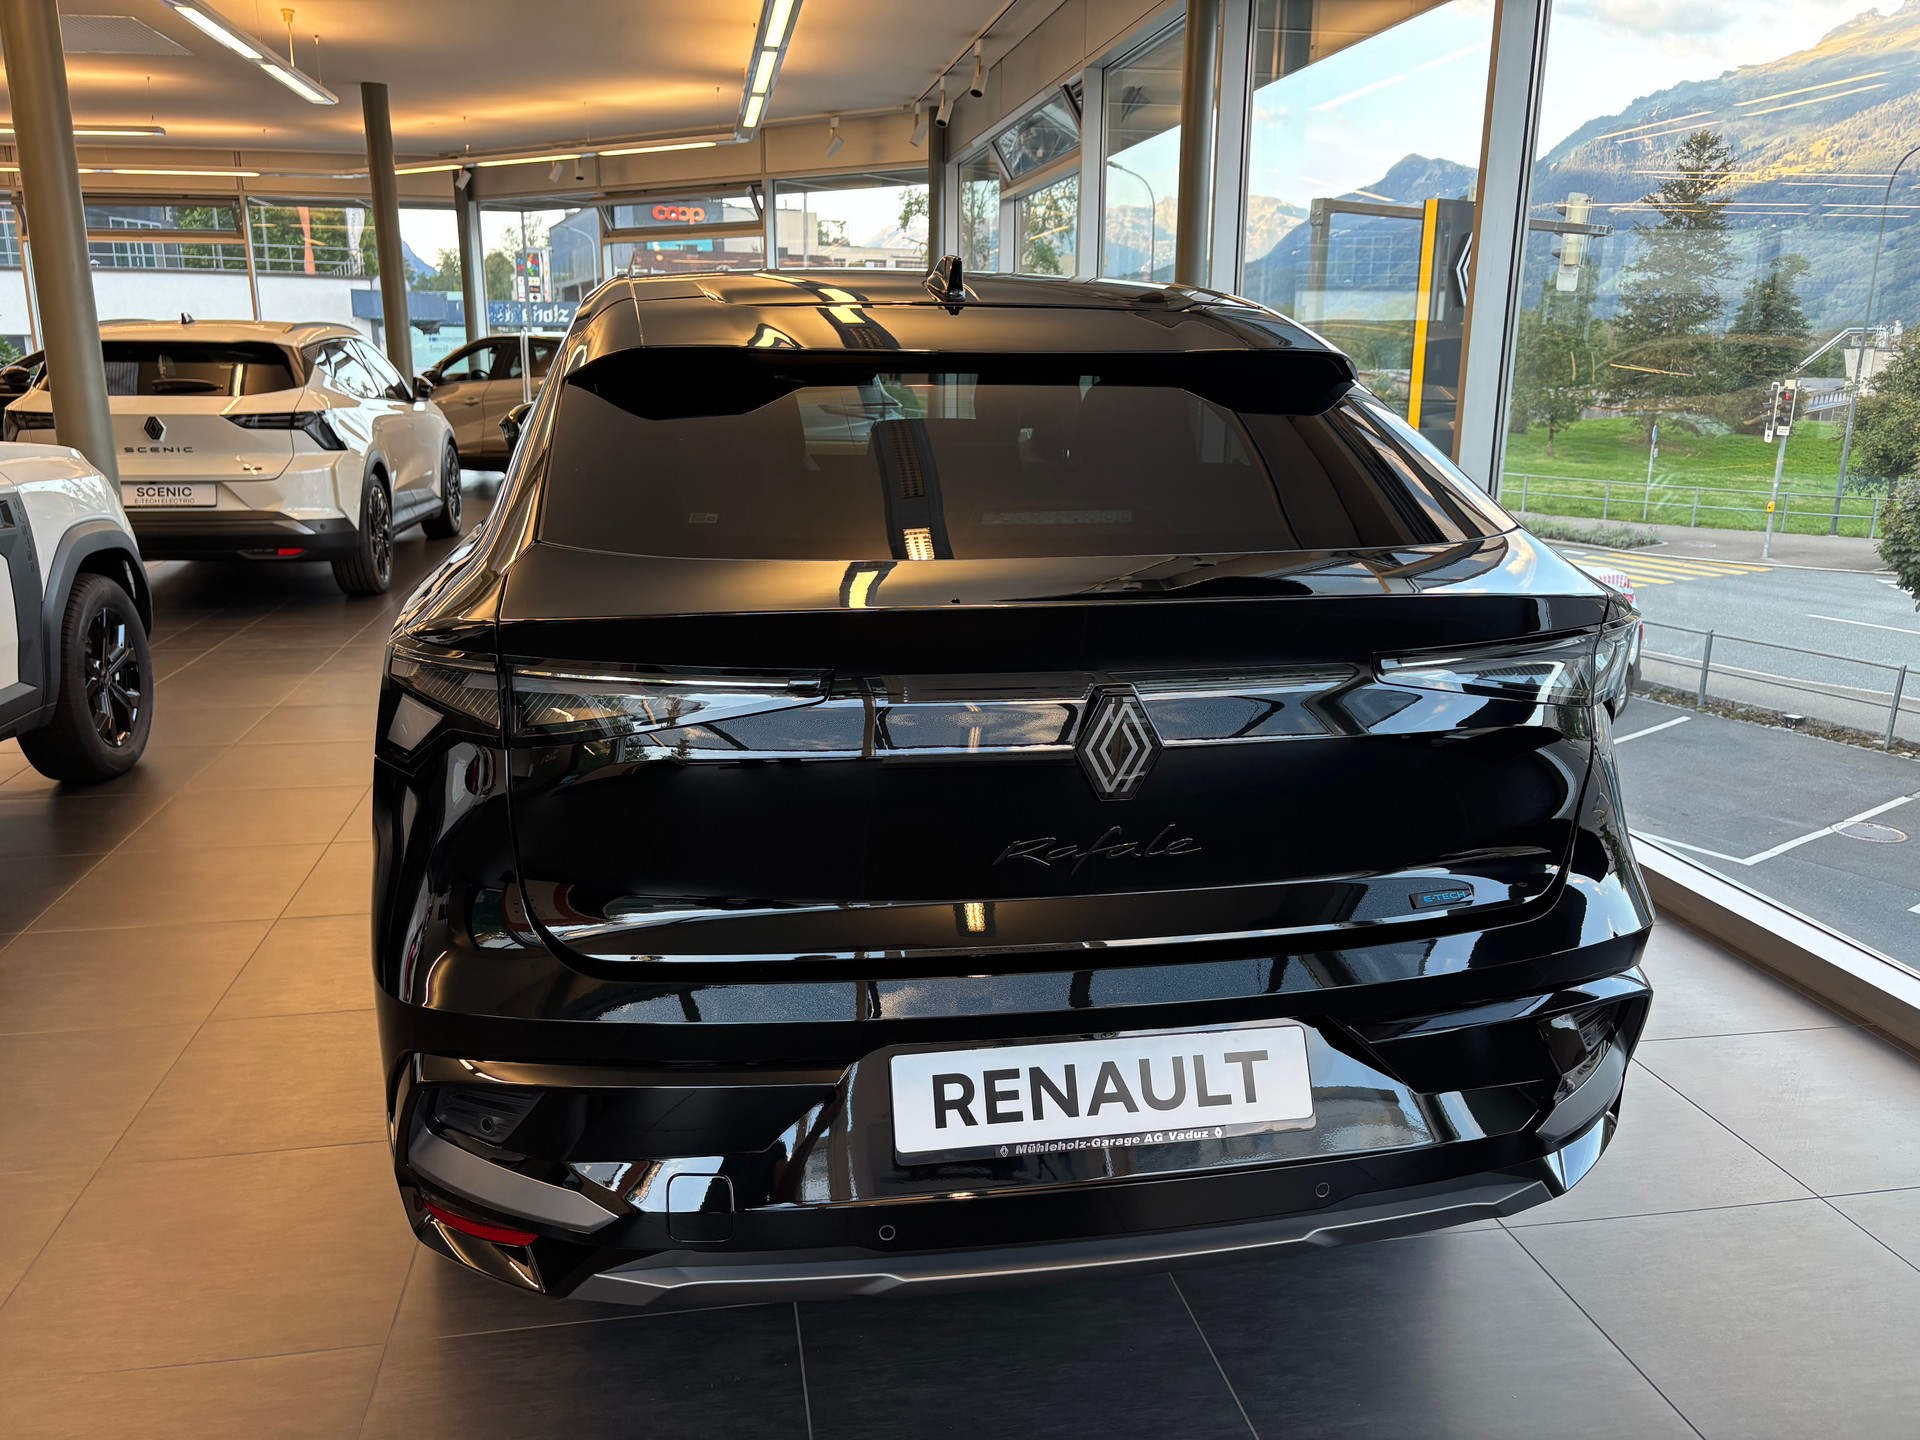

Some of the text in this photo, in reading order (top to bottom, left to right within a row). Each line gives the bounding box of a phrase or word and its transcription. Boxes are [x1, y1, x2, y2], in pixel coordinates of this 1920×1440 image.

[652, 205, 705, 225] coop
[136, 486, 192, 497] SCENIC
[992, 822, 1202, 876] Rafale
[1423, 890, 1466, 903] E-TECH
[931, 1049, 1269, 1129] RENAULT
[1015, 1129, 1209, 1155] Mühleholz-Garage AG Vaduz
